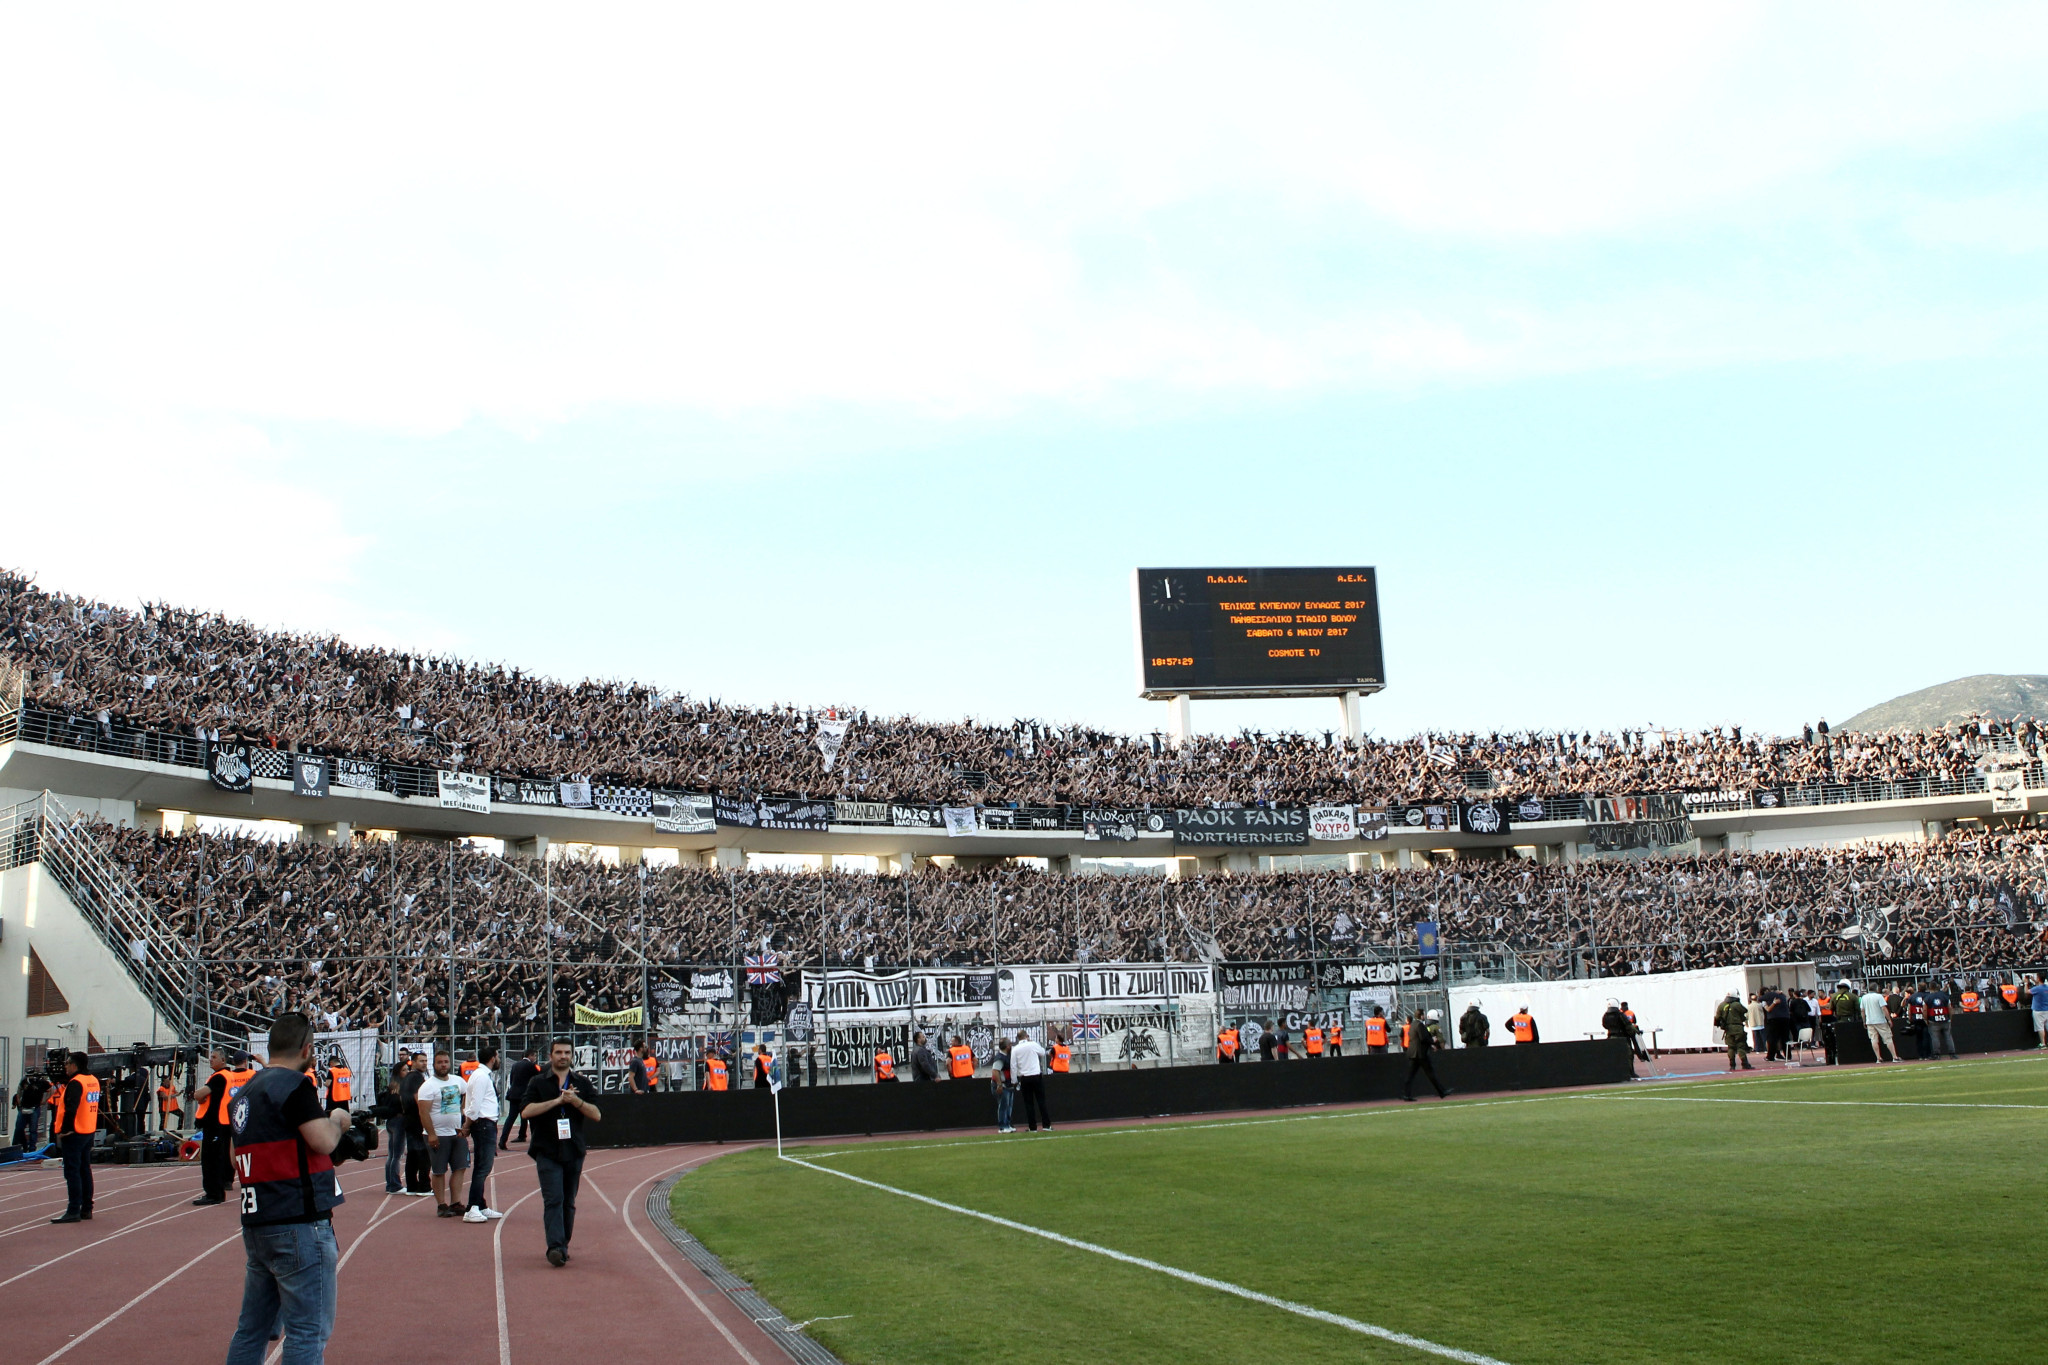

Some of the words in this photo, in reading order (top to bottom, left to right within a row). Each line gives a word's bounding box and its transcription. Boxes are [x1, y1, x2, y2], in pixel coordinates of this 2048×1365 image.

[1207, 575, 1248, 584] Π.Α.Ο.Κ.
[1337, 574, 1367, 583] Α.Ε.Κ.
[1219, 602, 1257, 610] ΤΕΛΙΚΟΣ
[1260, 601, 1301, 610] ΚΥΠΕΛΛΟΥ
[1305, 601, 1341, 609] ΕΛΛΑΔΟΣ
[1344, 601, 1365, 609] 2017
[1230, 615, 1293, 624] ΠΑΝΘΕΣΣΑΛΙΚΟ
[1296, 615, 1327, 623] ΣΤΑΔΙΟ
[1331, 615, 1357, 623] ΒΟΛΟΥ
[1246, 629, 1283, 637] ΣΑΒΒΑΤΟ
[1287, 629, 1293, 637] 6
[1297, 628, 1324, 637] ΜΑΙΟΥ
[1327, 628, 1348, 636] 2017
[1268, 649, 1305, 657] COSMOTE
[1308, 648, 1320, 657] TV
[1151, 657, 1193, 666] 18:57:29
[302, 788, 323, 796] ΧΙΟΣ
[521, 790, 556, 804] ΧΑΝΙΑ
[1683, 790, 1747, 804] ΚΟΠΑΝΟΣ
[595, 794, 651, 807] ΠΟΛΥΓΥΡΟΣ
[716, 808, 737, 820] FANS
[1312, 809, 1350, 822] ΠΑΟΚΑΡΑ
[1425, 806, 1447, 816] TRIKALA
[1176, 809, 1236, 825] PAOK
[1243, 809, 1303, 825] FANS
[1315, 823, 1350, 833] ΟΧΥΡΟ
[1179, 831, 1305, 843] NORTHERNERS
[1030, 974, 1051, 998] ΣΕ
[1097, 972, 1120, 996] ΤΗ
[1171, 970, 1209, 994] ΜΑΣ
[1238, 984, 1294, 1010] ΛΑΓΚΑΔΑΣ
[235, 1152, 252, 1178] TV
